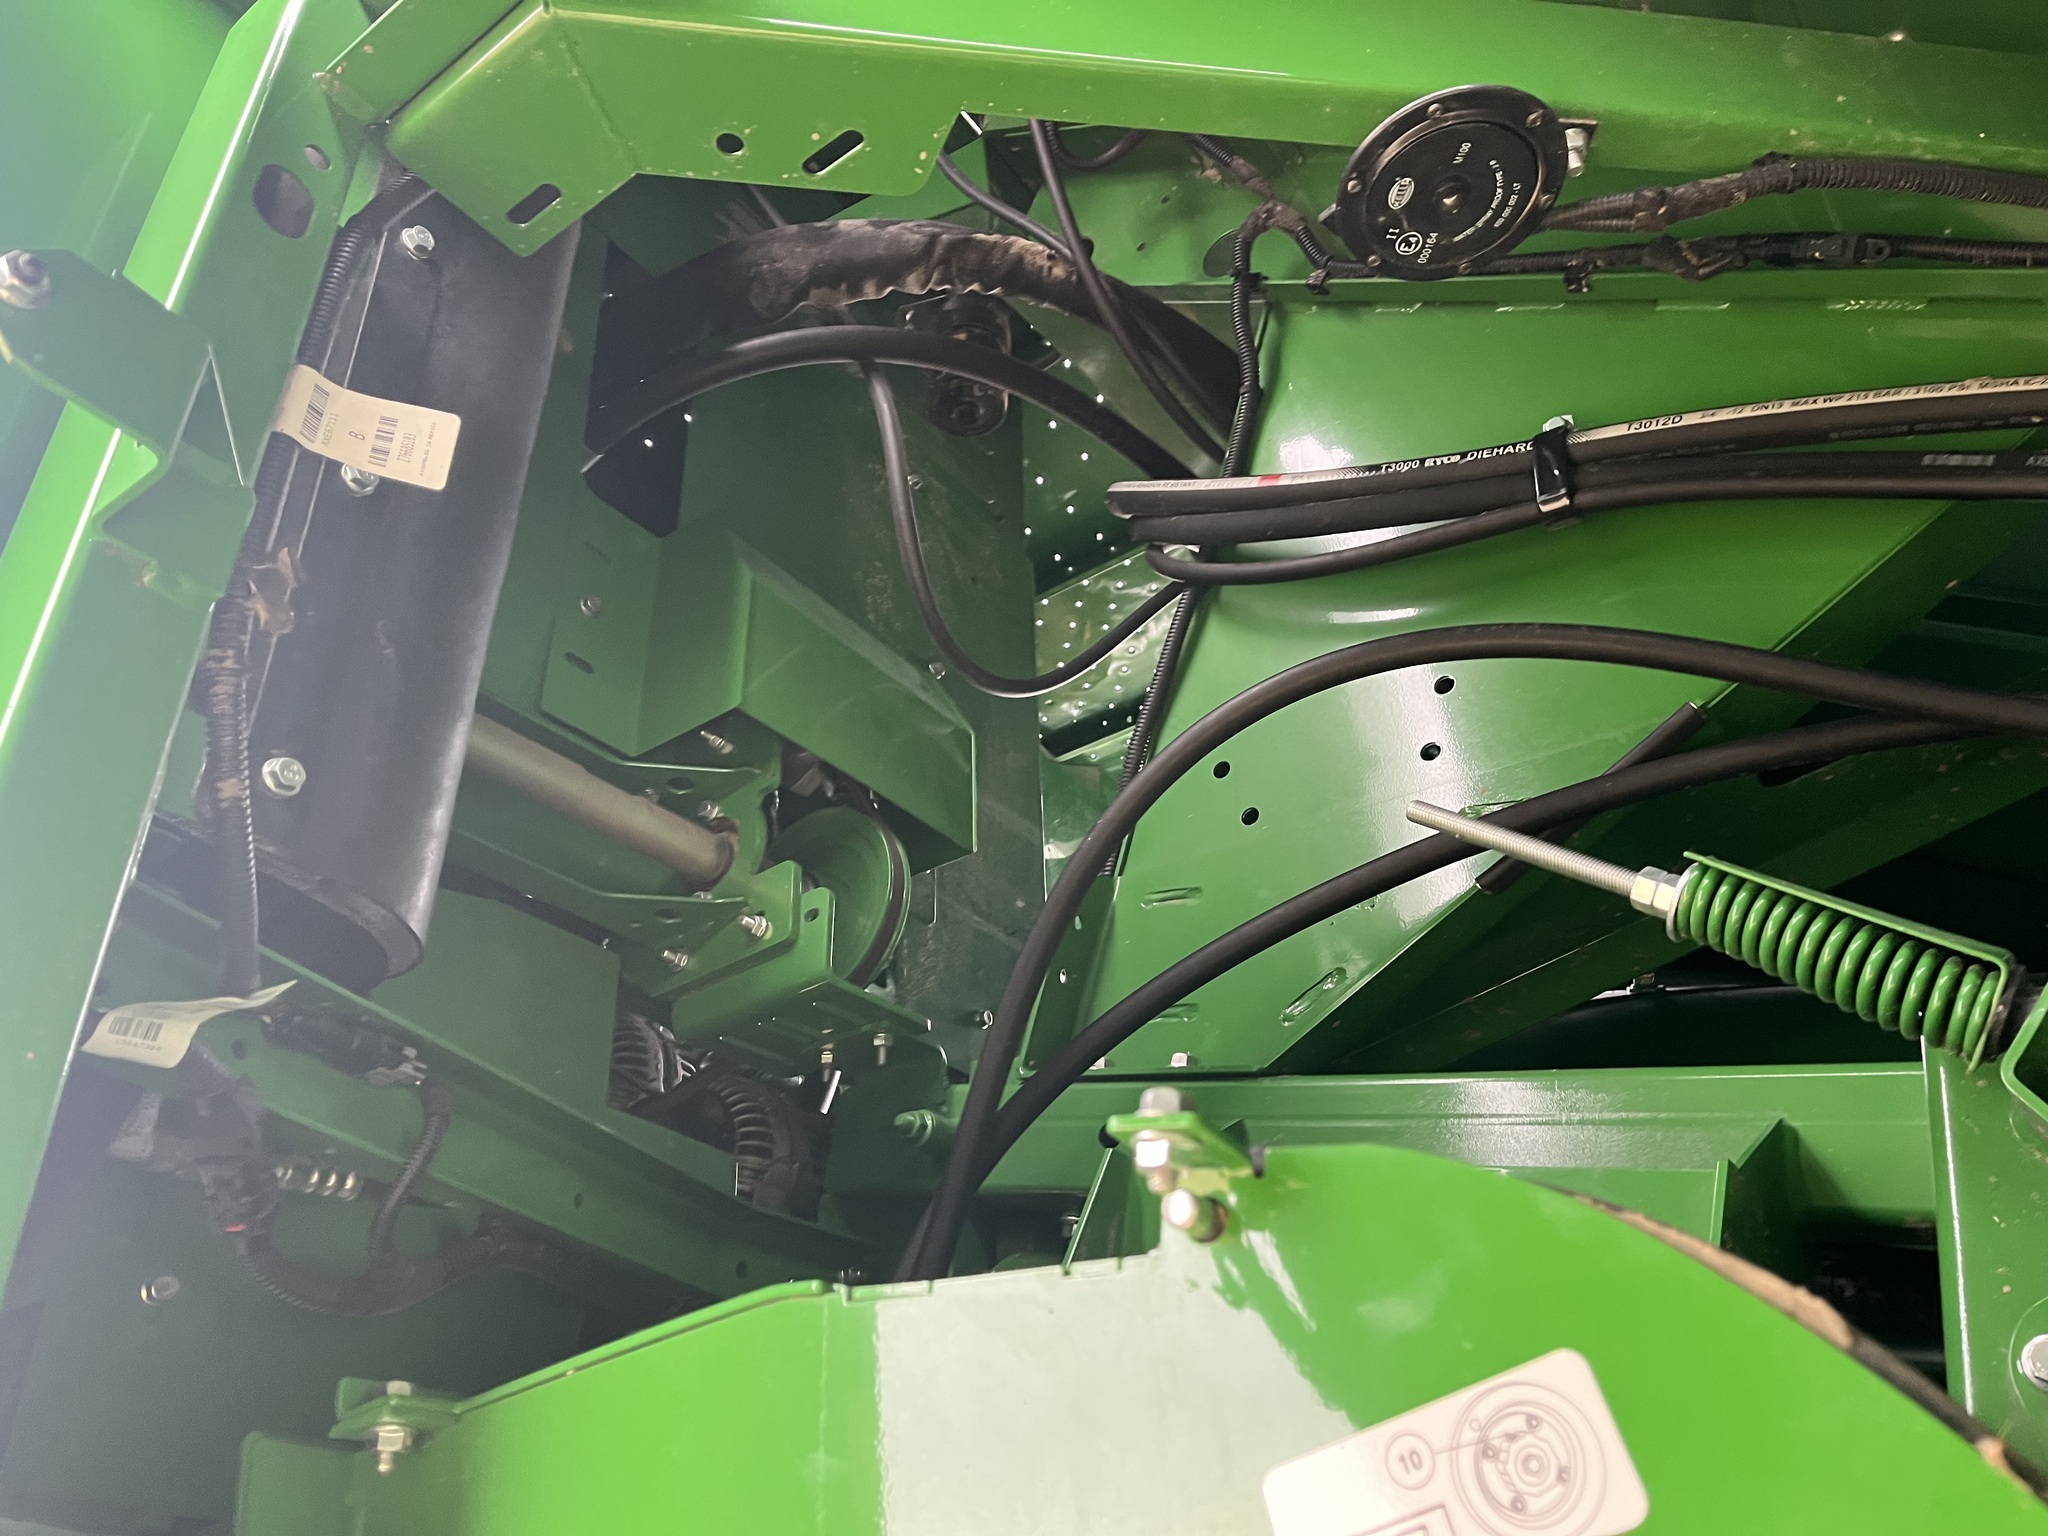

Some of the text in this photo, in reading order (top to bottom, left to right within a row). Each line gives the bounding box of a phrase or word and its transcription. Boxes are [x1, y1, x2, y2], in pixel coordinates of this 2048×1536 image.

[1452, 142, 1472, 164] M100
[1417, 232, 1438, 264] 000164
[1627, 415, 1683, 431] T3012D
[1789, 397, 1819, 408] MAX
[1822, 395, 1845, 404] WP
[1872, 389, 1903, 399] BAR
[322, 412, 340, 447] AXE67111
[397, 433, 417, 463] 276685183
[1380, 460, 1420, 473] T3000
[1424, 454, 1461, 467] RYCO
[1398, 1449, 1423, 1474] 10
